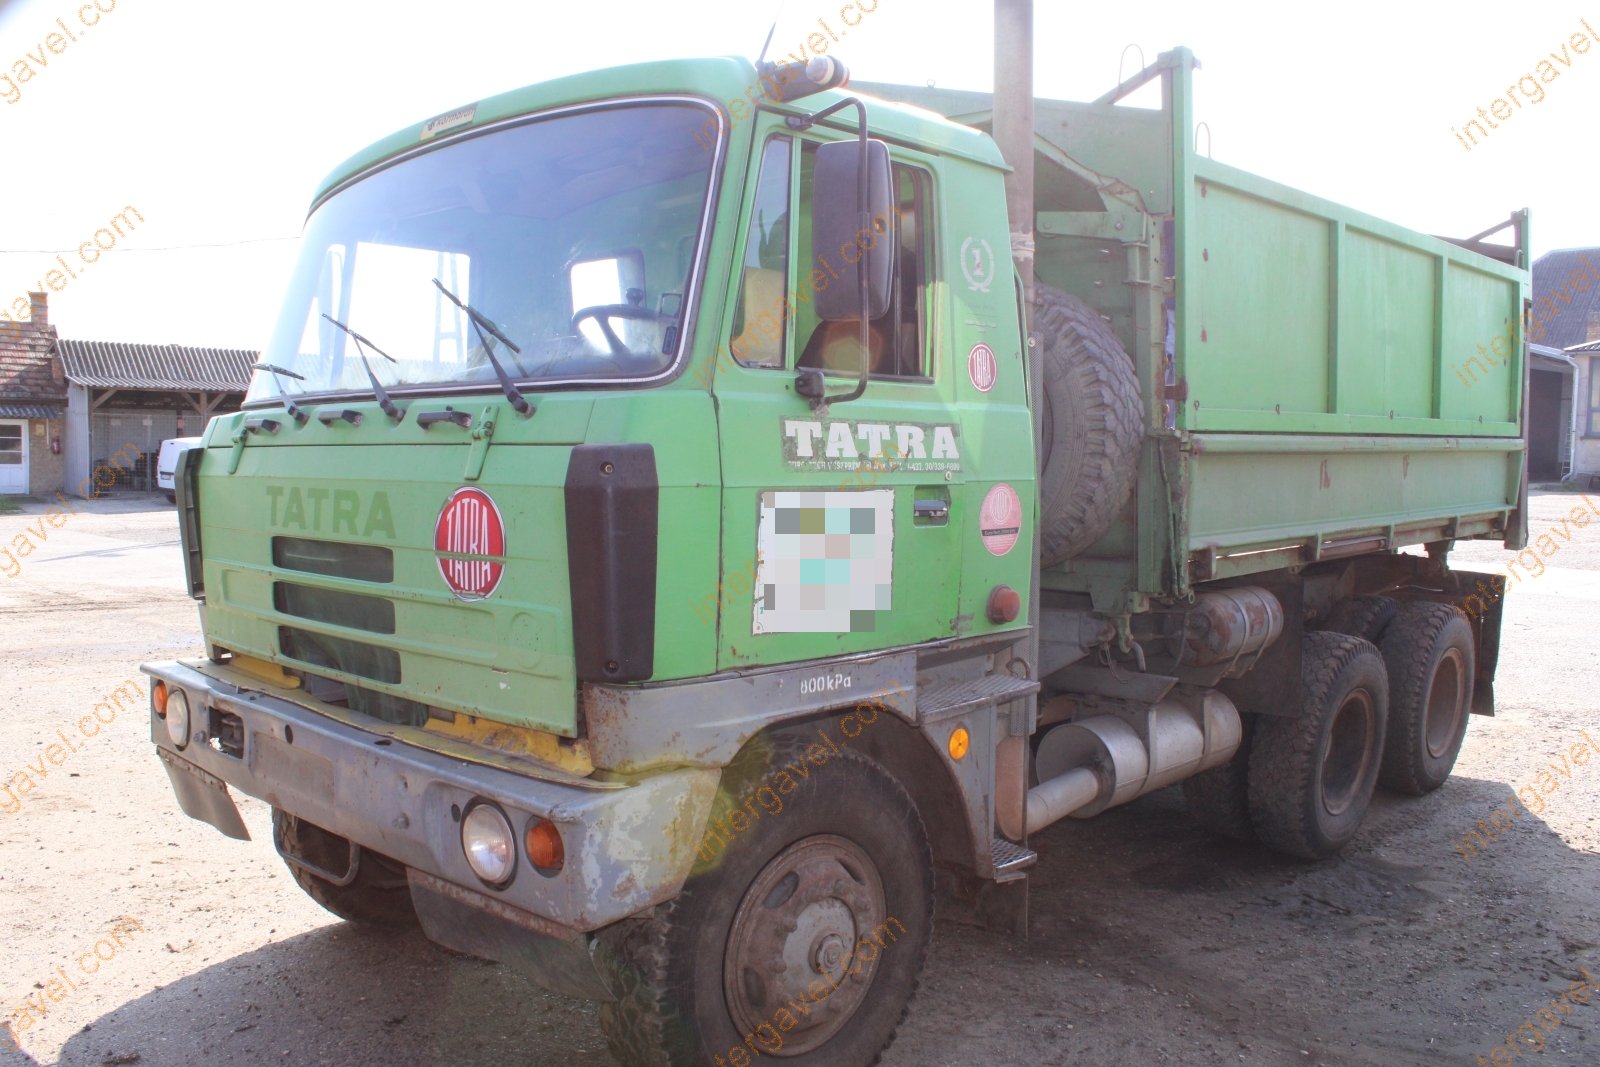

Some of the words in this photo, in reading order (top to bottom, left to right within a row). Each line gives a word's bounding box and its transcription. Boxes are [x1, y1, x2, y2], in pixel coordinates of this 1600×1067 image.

[785, 420, 960, 459] TATRA
[266, 485, 397, 540] TATRA
[446, 497, 491, 592] TATRA
